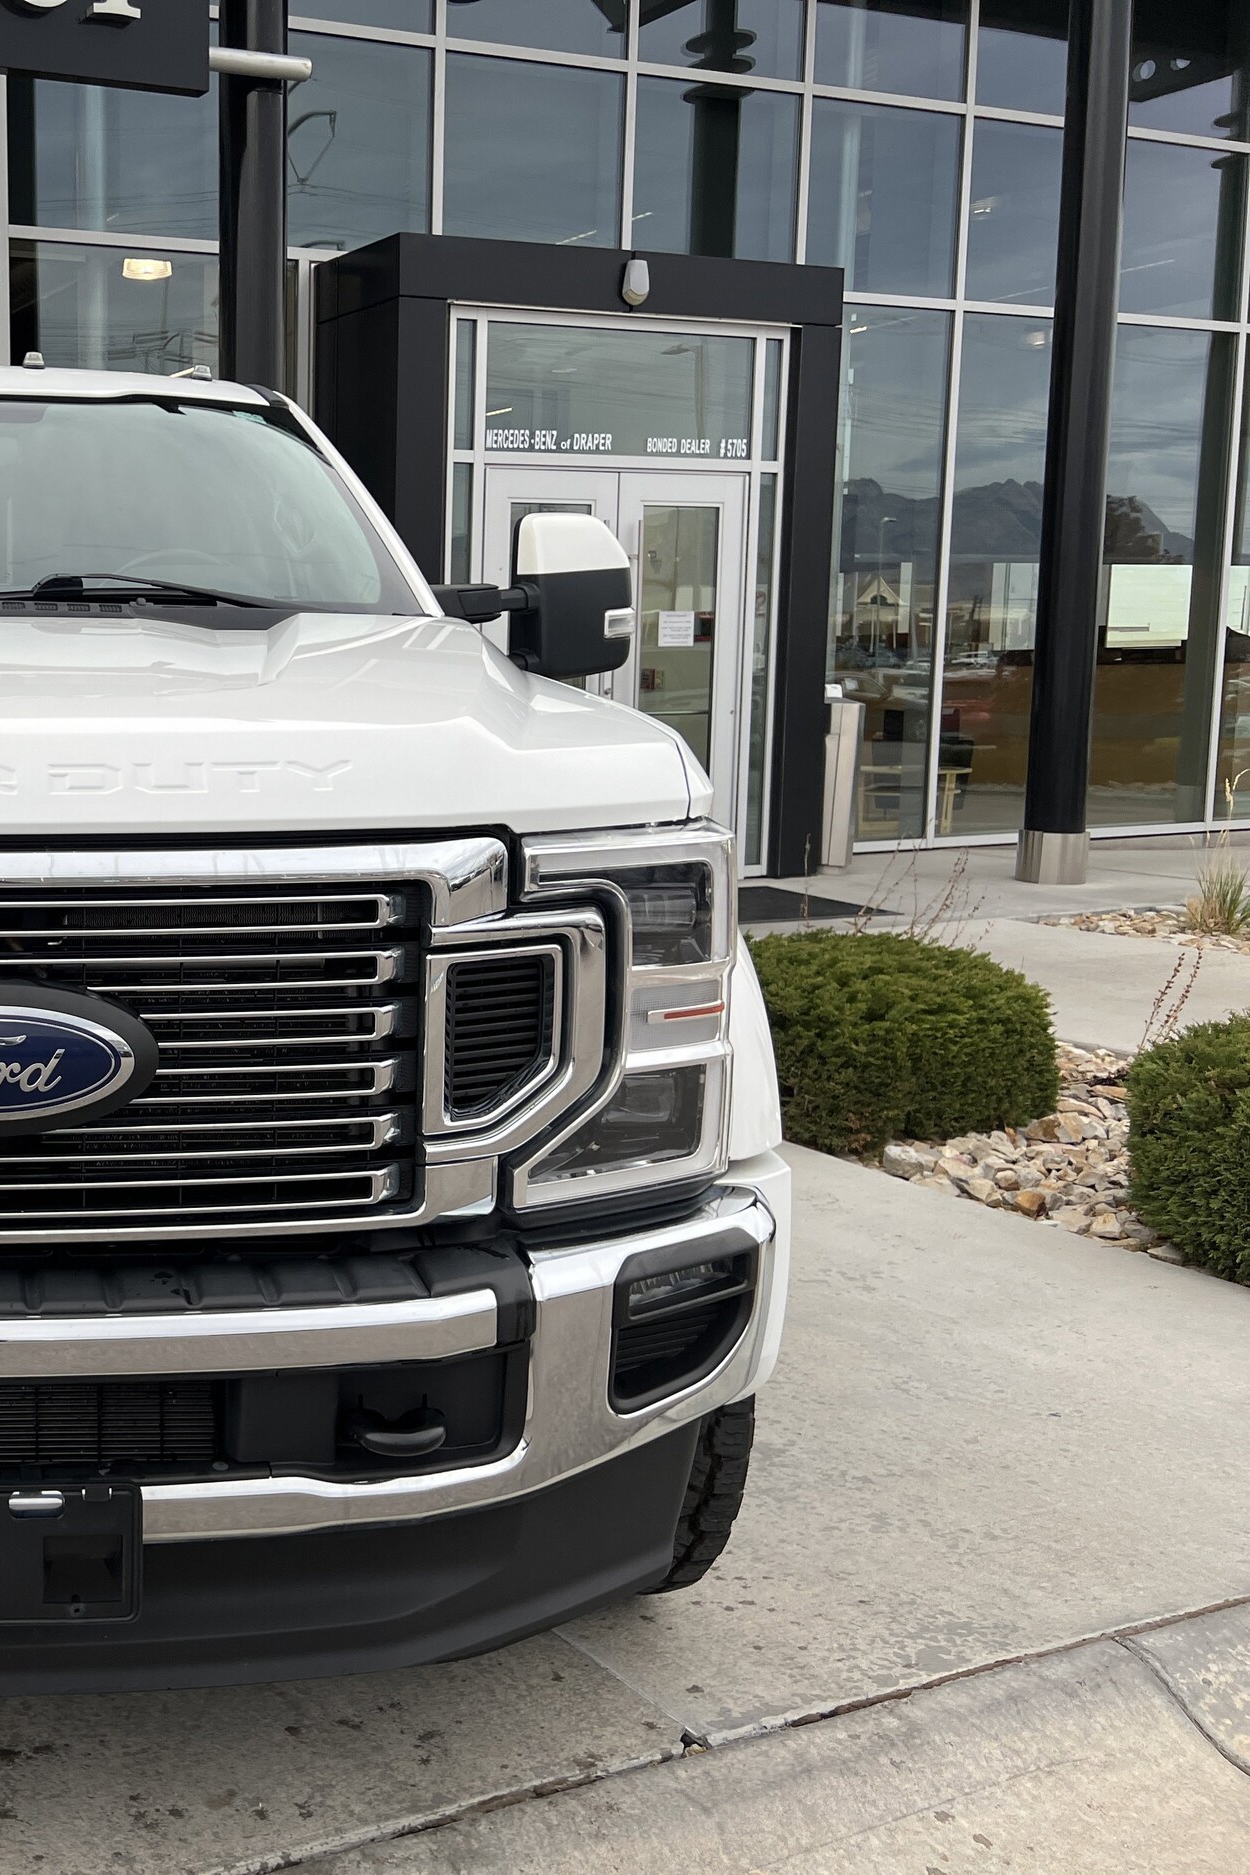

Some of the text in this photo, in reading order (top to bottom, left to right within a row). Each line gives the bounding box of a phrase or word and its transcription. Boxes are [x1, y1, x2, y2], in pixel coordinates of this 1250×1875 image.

[560, 438, 571, 450] of
[573, 433, 612, 451] DRAPER
[646, 438, 678, 453] BONDED
[680, 439, 711, 454] DEALER
[49, 759, 353, 794] DUTY
